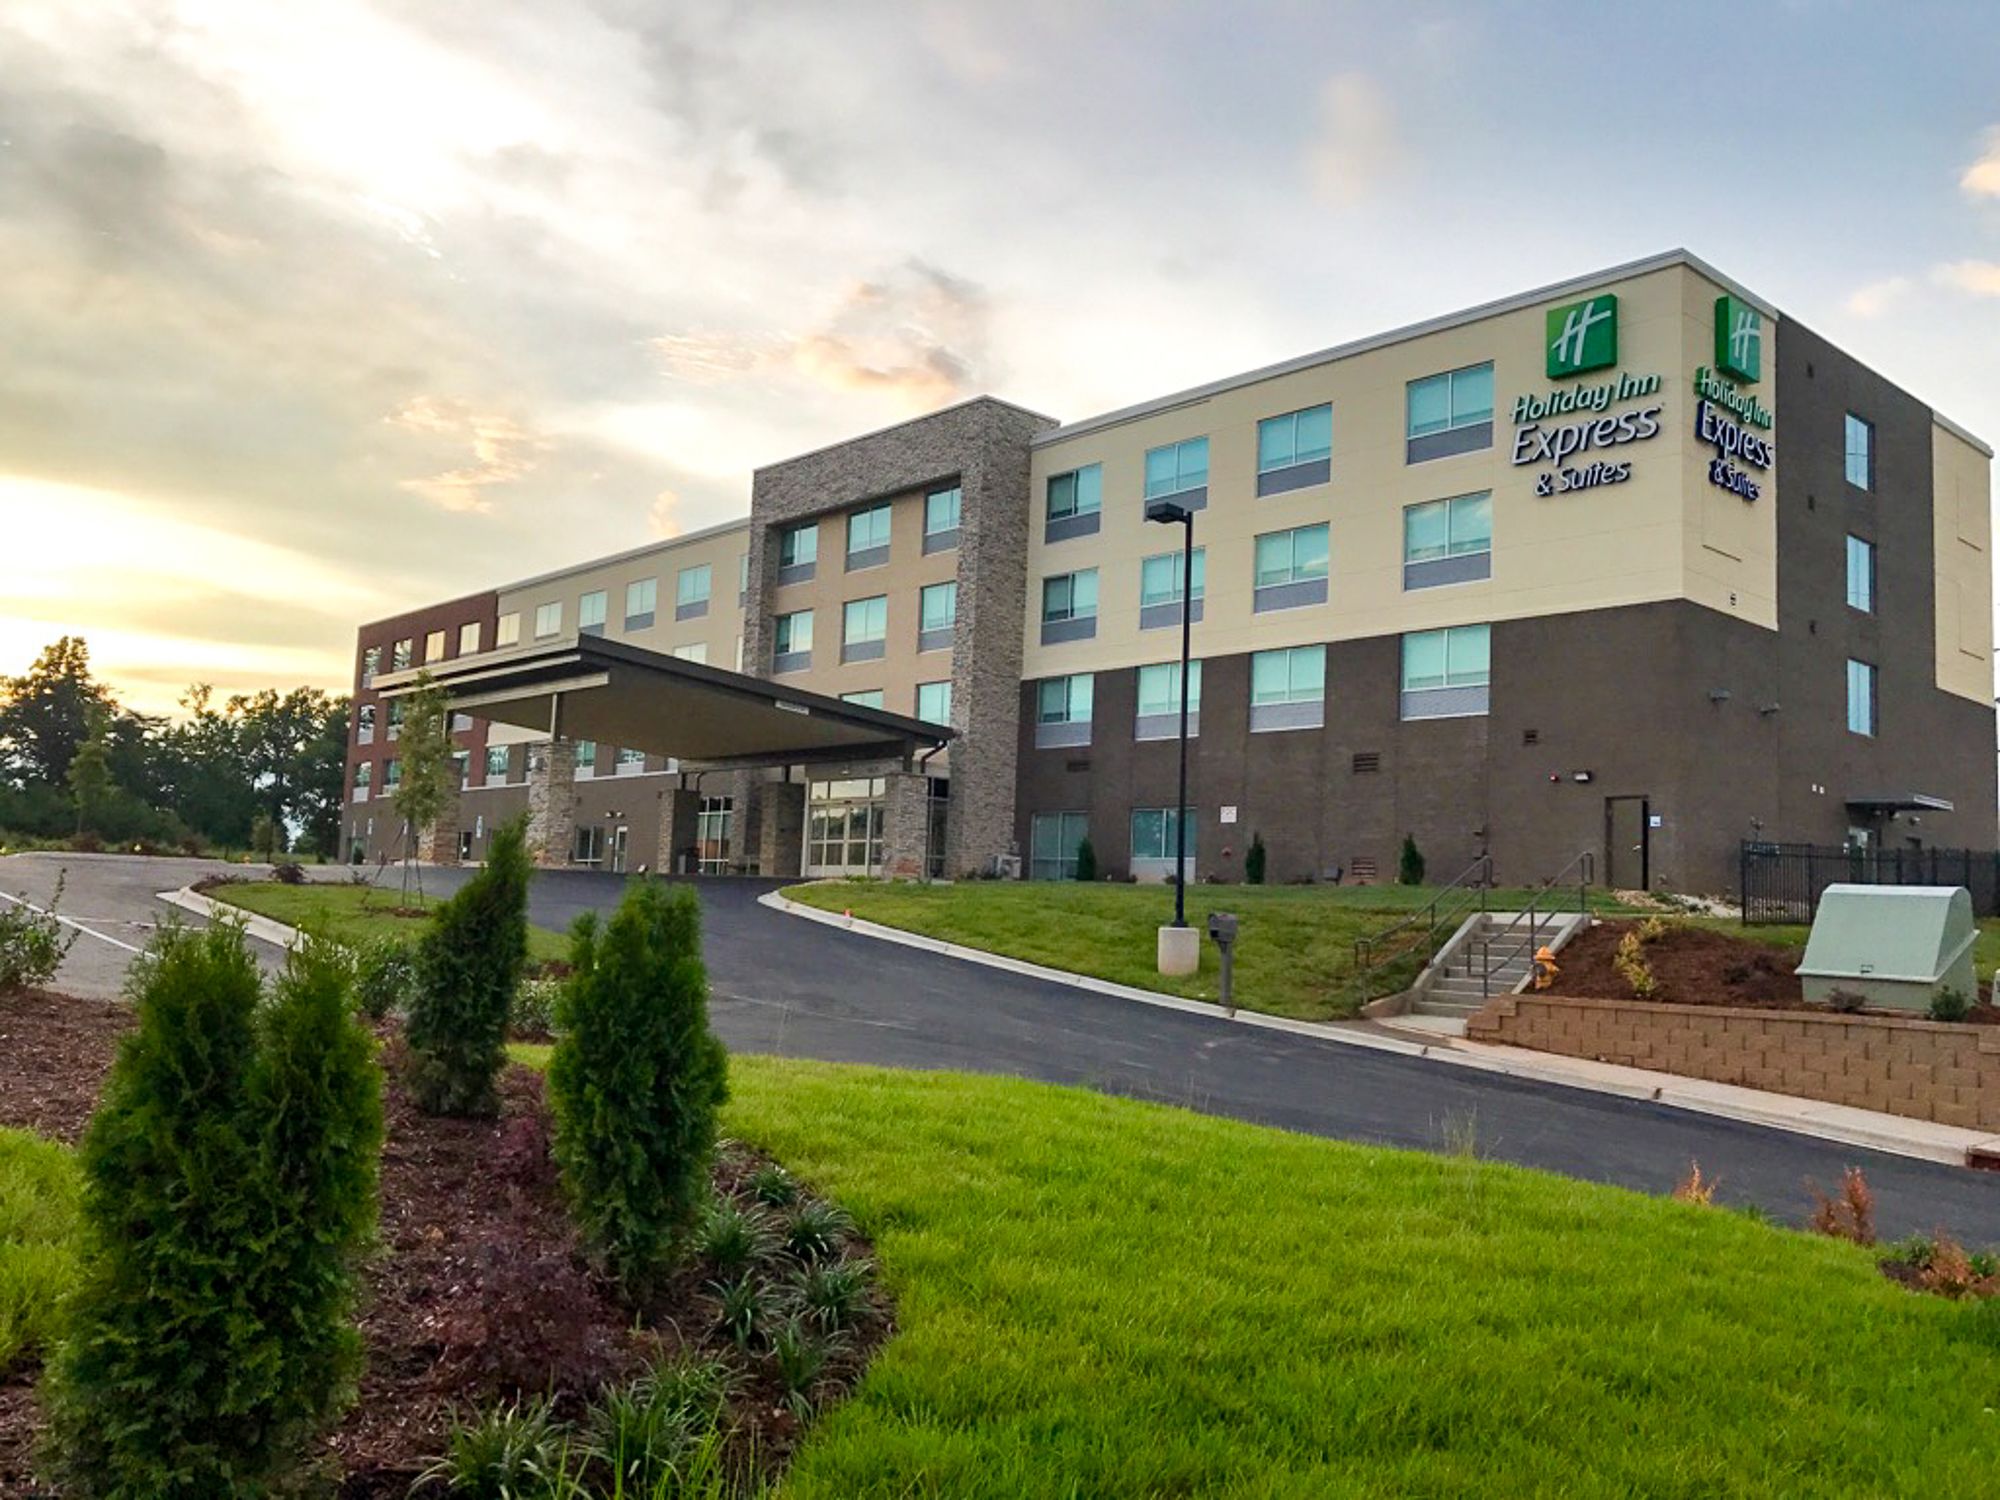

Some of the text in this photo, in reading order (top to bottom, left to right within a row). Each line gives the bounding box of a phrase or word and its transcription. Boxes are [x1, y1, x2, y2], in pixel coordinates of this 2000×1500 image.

[1511, 372, 1660, 423] Holiday Inn
[1697, 367, 1772, 429] Holiday Inn
[1511, 406, 1662, 467] Express
[1698, 399, 1773, 470] Express
[1534, 461, 1631, 497] & Suites
[1726, 468, 1761, 501] Suites
